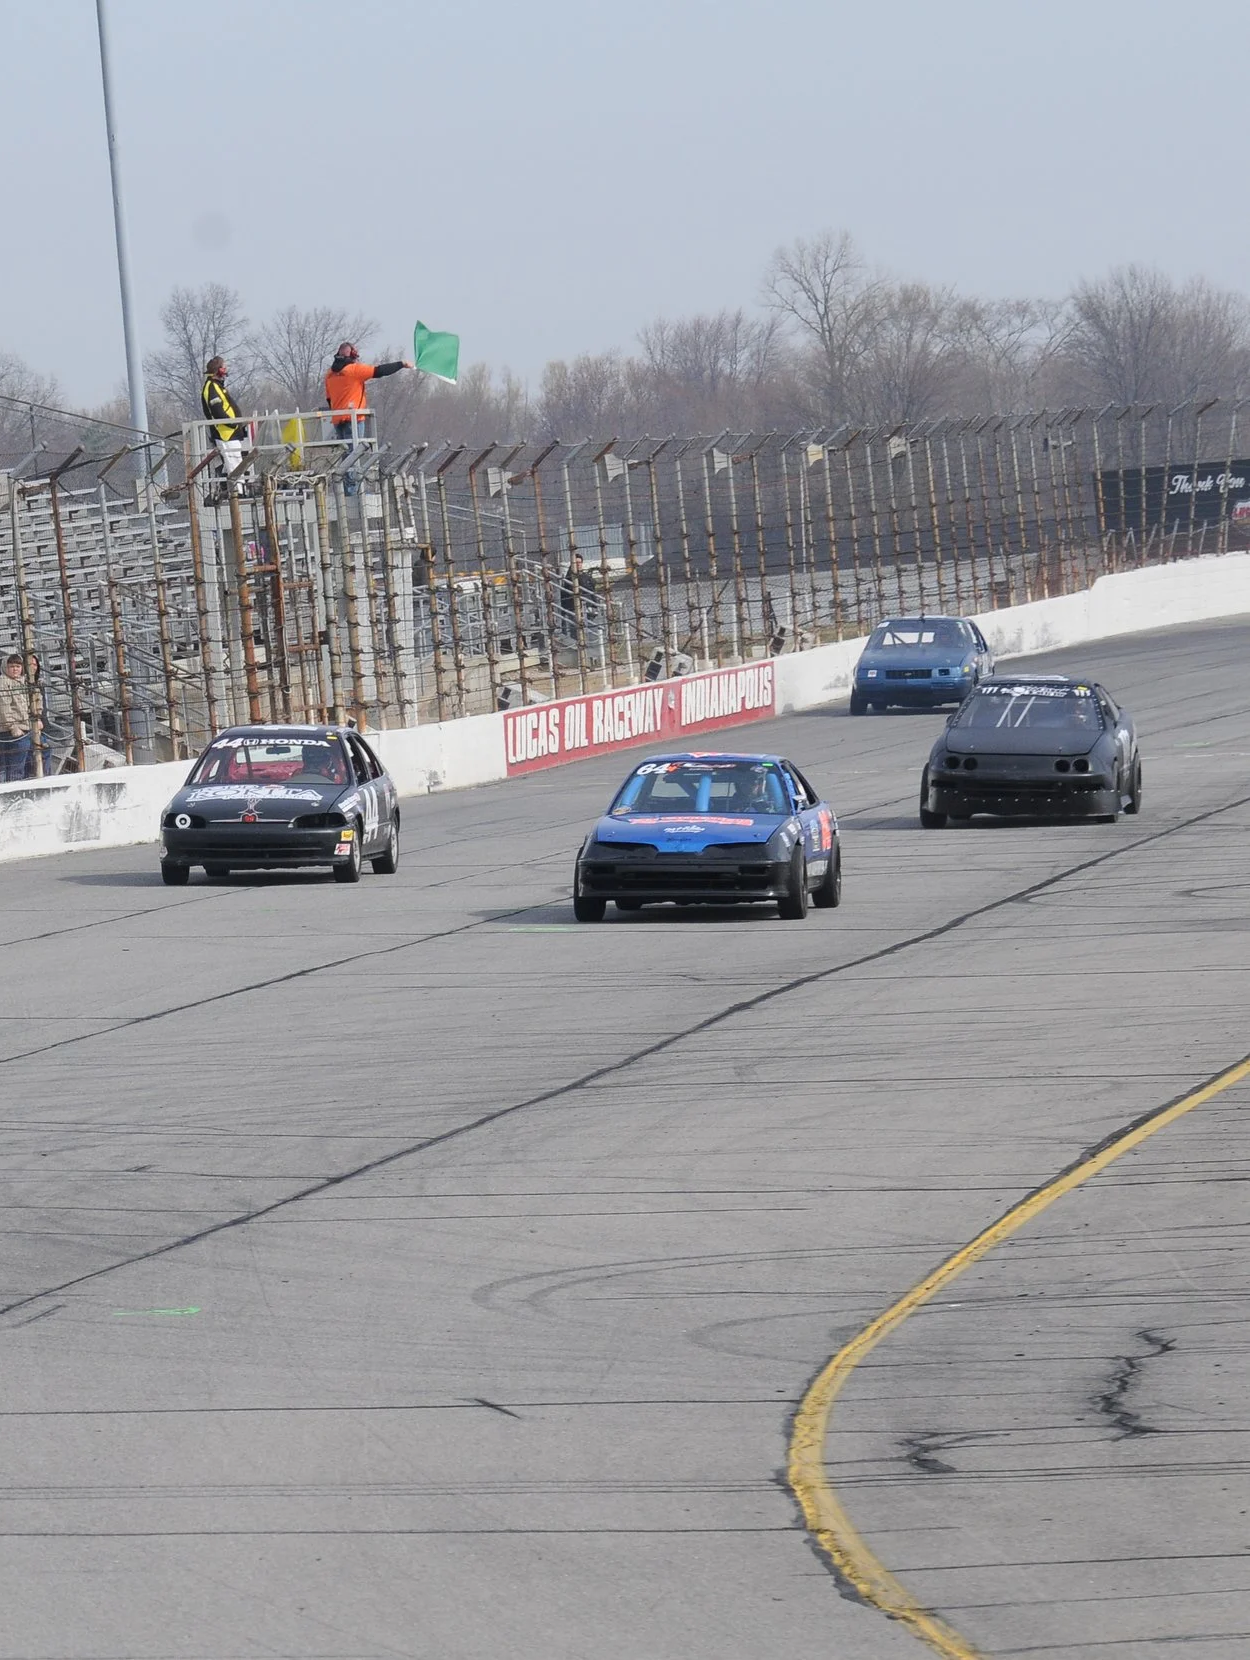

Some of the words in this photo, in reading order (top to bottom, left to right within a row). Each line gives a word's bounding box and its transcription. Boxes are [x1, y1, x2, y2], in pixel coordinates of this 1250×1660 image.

[507, 707, 560, 764] LUCAS
[564, 702, 589, 751] OIL
[592, 687, 664, 745] RACEWAY
[681, 665, 773, 727] INDIANAPOLIS
[211, 738, 244, 750] 44
[260, 739, 331, 748] HONDA
[636, 763, 670, 775] 64
